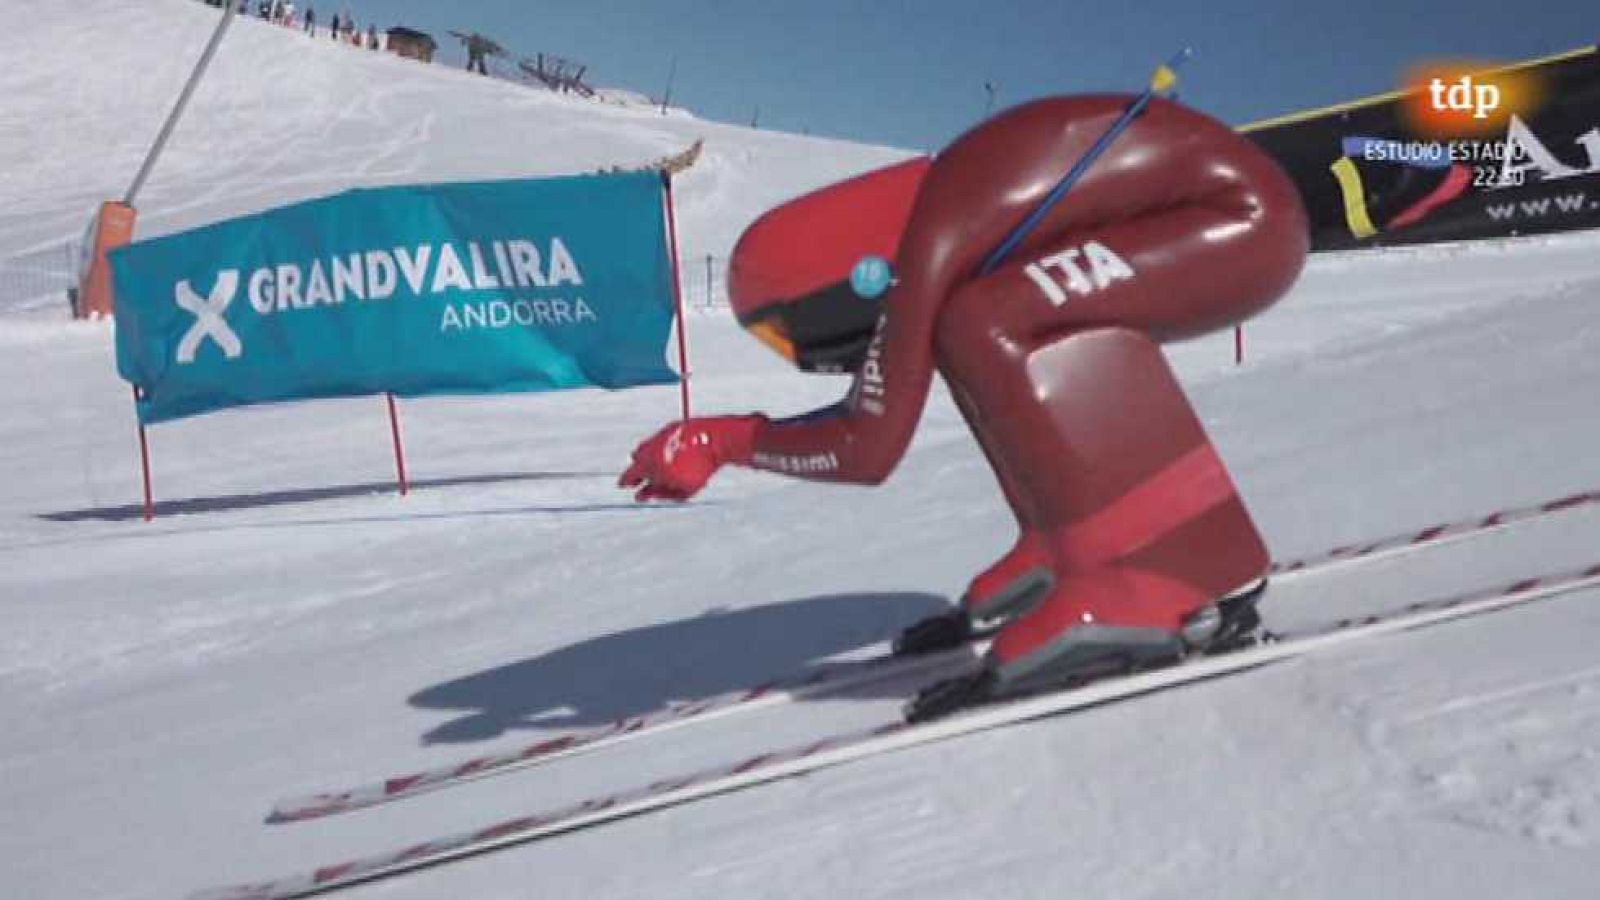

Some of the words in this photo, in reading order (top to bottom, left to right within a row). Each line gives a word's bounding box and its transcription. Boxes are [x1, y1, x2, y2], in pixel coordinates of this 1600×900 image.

[248, 236, 584, 314] GRANDVALIRA
[1023, 239, 1136, 307] ITA
[440, 295, 598, 334] ANDORRA
